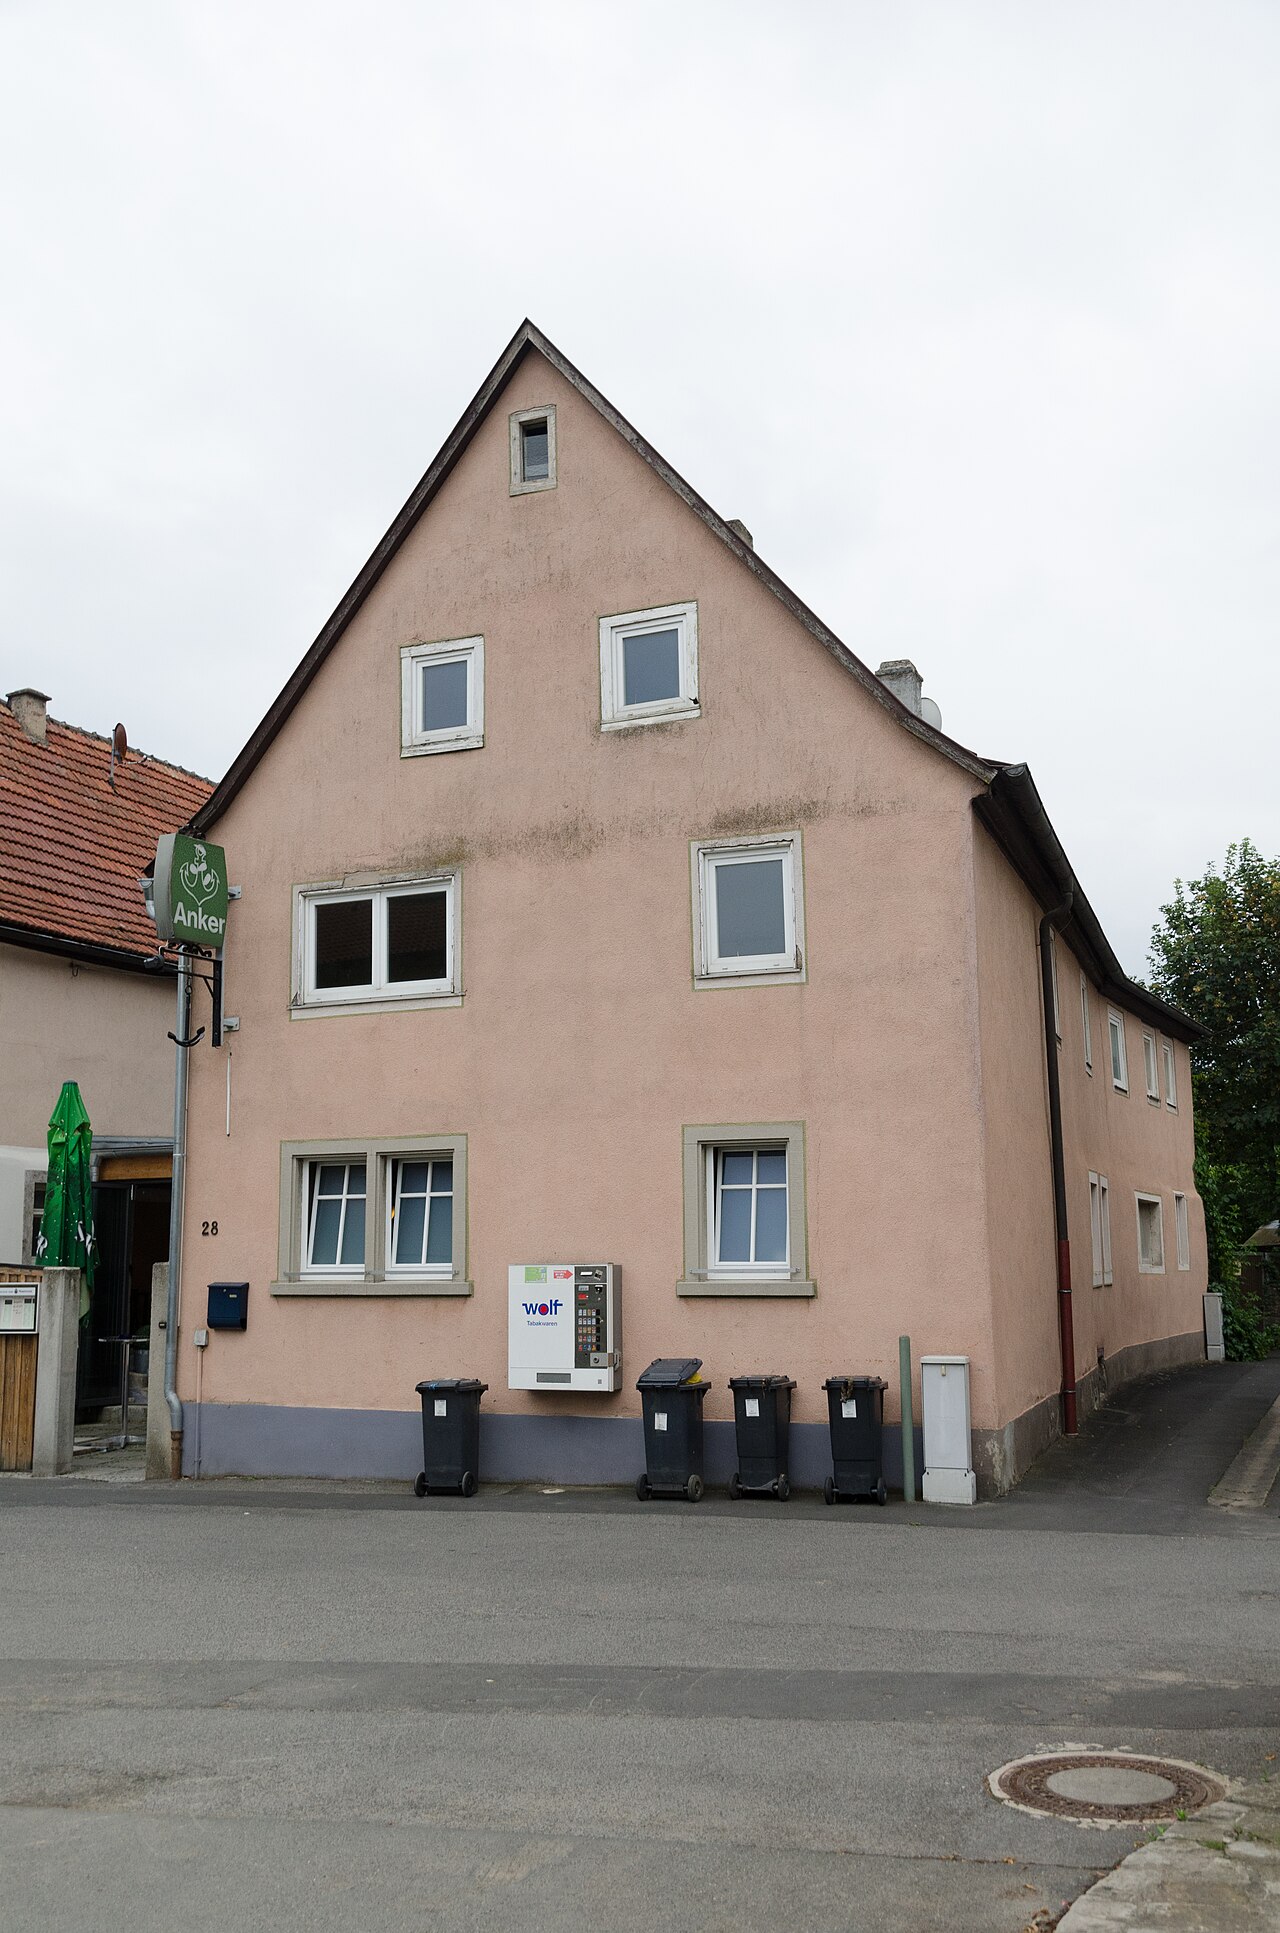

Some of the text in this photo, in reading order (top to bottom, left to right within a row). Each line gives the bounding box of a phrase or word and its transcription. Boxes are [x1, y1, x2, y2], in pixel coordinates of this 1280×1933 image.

[173, 901, 226, 934] Anker
[201, 1221, 219, 1236] 28
[522, 1299, 563, 1316] wolf
